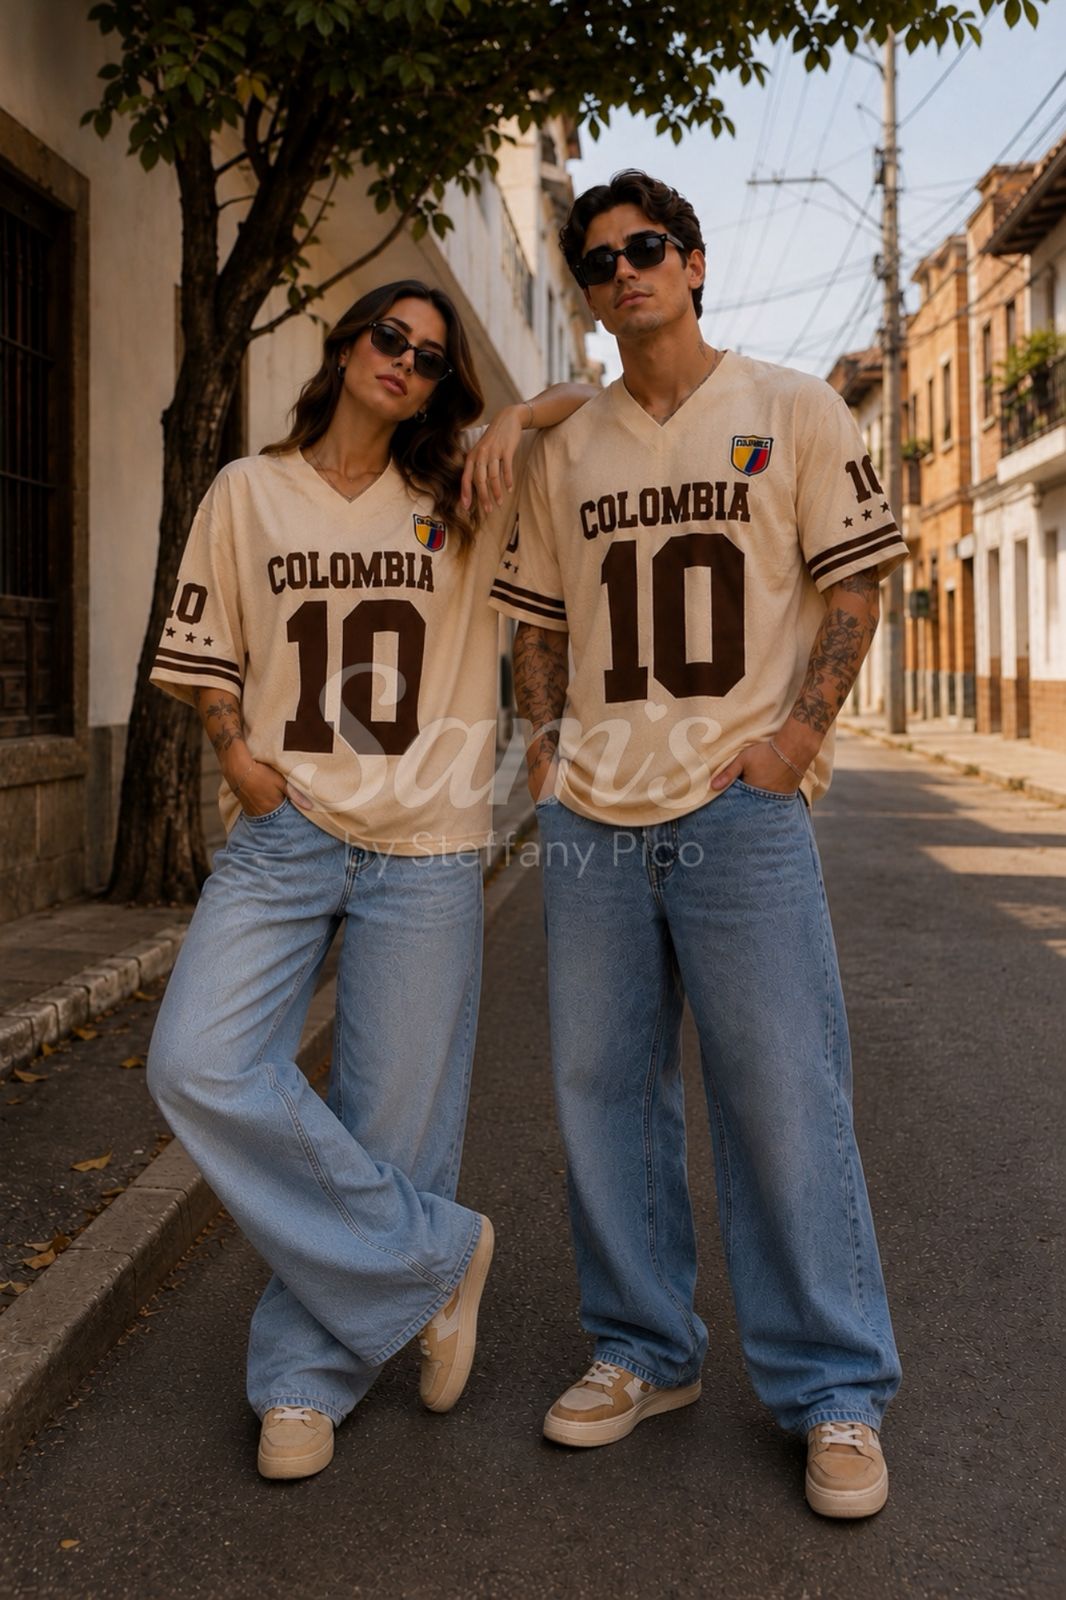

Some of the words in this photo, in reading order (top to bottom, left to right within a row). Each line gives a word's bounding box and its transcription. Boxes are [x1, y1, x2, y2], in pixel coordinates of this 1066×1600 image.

[579, 481, 751, 541] COLOMBIA
[166, 579, 208, 625] 0
[267, 551, 435, 596] COLOMBIA
[600, 532, 746, 704] 10
[283, 599, 427, 756] 10
